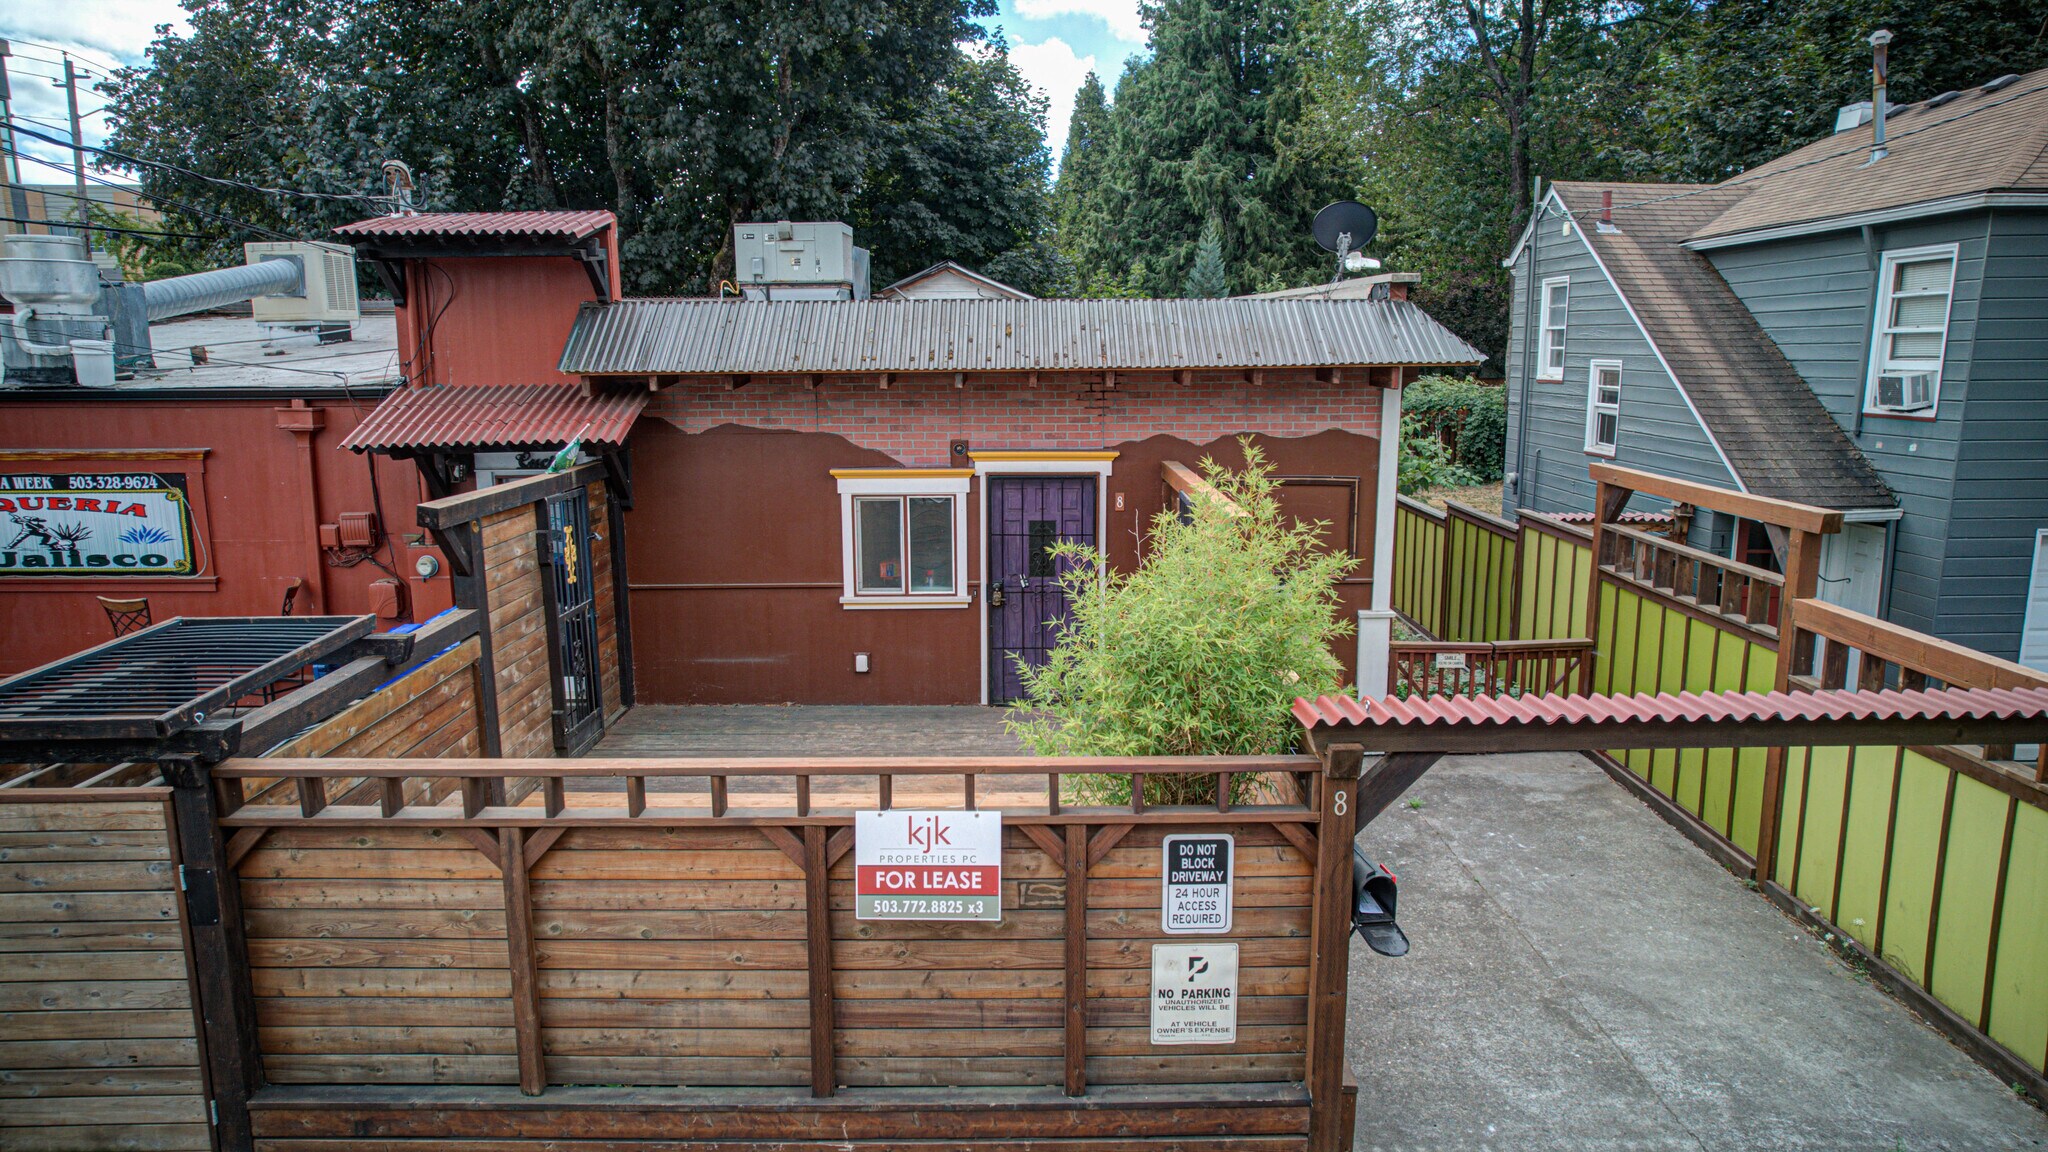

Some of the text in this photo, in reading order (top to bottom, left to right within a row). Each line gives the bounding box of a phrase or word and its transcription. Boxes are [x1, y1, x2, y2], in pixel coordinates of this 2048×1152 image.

[0, 475, 158, 490] A WEEK 503-328-9624
[1116, 495, 1124, 508] 8
[0, 550, 168, 568] Jalisco
[1334, 790, 1347, 816] 8
[908, 815, 951, 853] kjk
[1179, 844, 1217, 856] DO NOT
[879, 855, 977, 864] PROPERTIES PC
[1181, 857, 1215, 869] BLOCK
[875, 871, 982, 889] FOR LEASE
[1171, 870, 1224, 883] DRIVEWAY
[1175, 887, 1220, 899] 24 HOUR
[873, 900, 984, 914] 503.772.8825 x3
[1177, 900, 1217, 911] ACCESS
[1172, 913, 1222, 924] REQUIRED
[1158, 987, 1231, 999] NO PARKING
